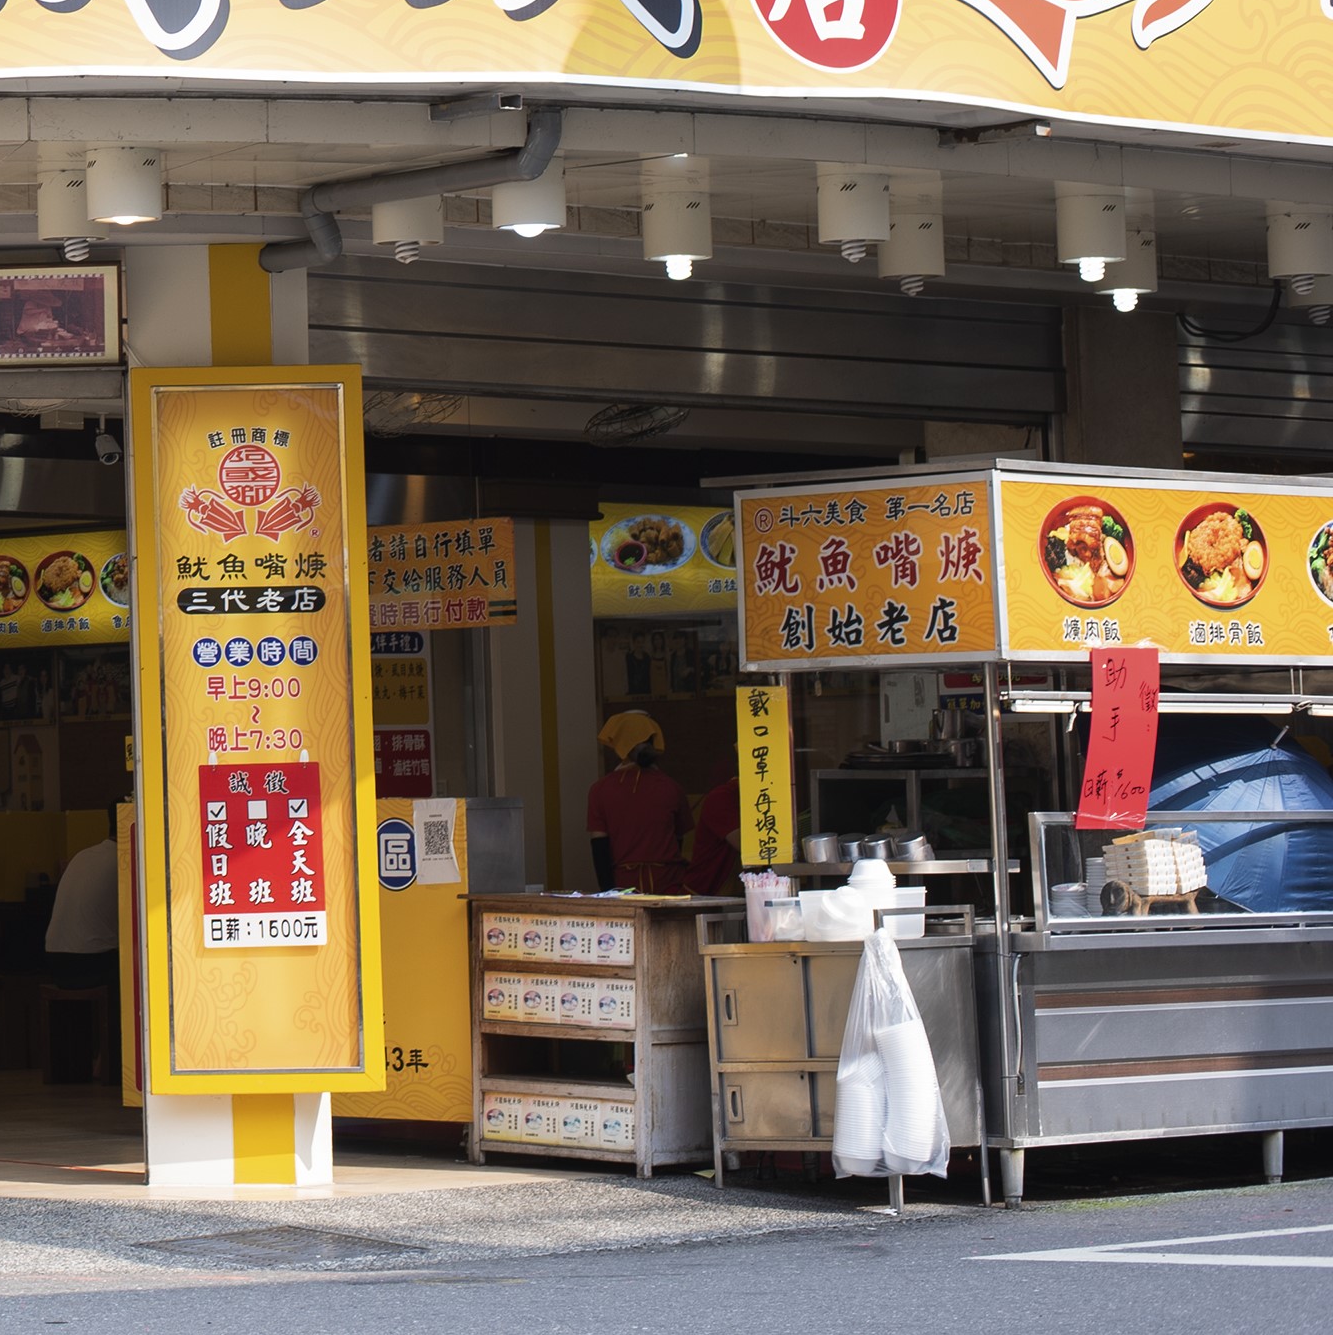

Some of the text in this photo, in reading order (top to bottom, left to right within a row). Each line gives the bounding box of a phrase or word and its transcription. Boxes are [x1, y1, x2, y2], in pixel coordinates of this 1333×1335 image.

[207, 427, 291, 449] 註冊商標
[779, 490, 976, 527] 斗六美食 第一名店
[185, 587, 319, 612] 三代老店
[779, 597, 961, 653] 創始老店
[1189, 620, 1265, 646] 滷排骨飯
[196, 639, 316, 664] 營業時間
[205, 821, 235, 907] 假日班
[287, 820, 317, 905] 全天班
